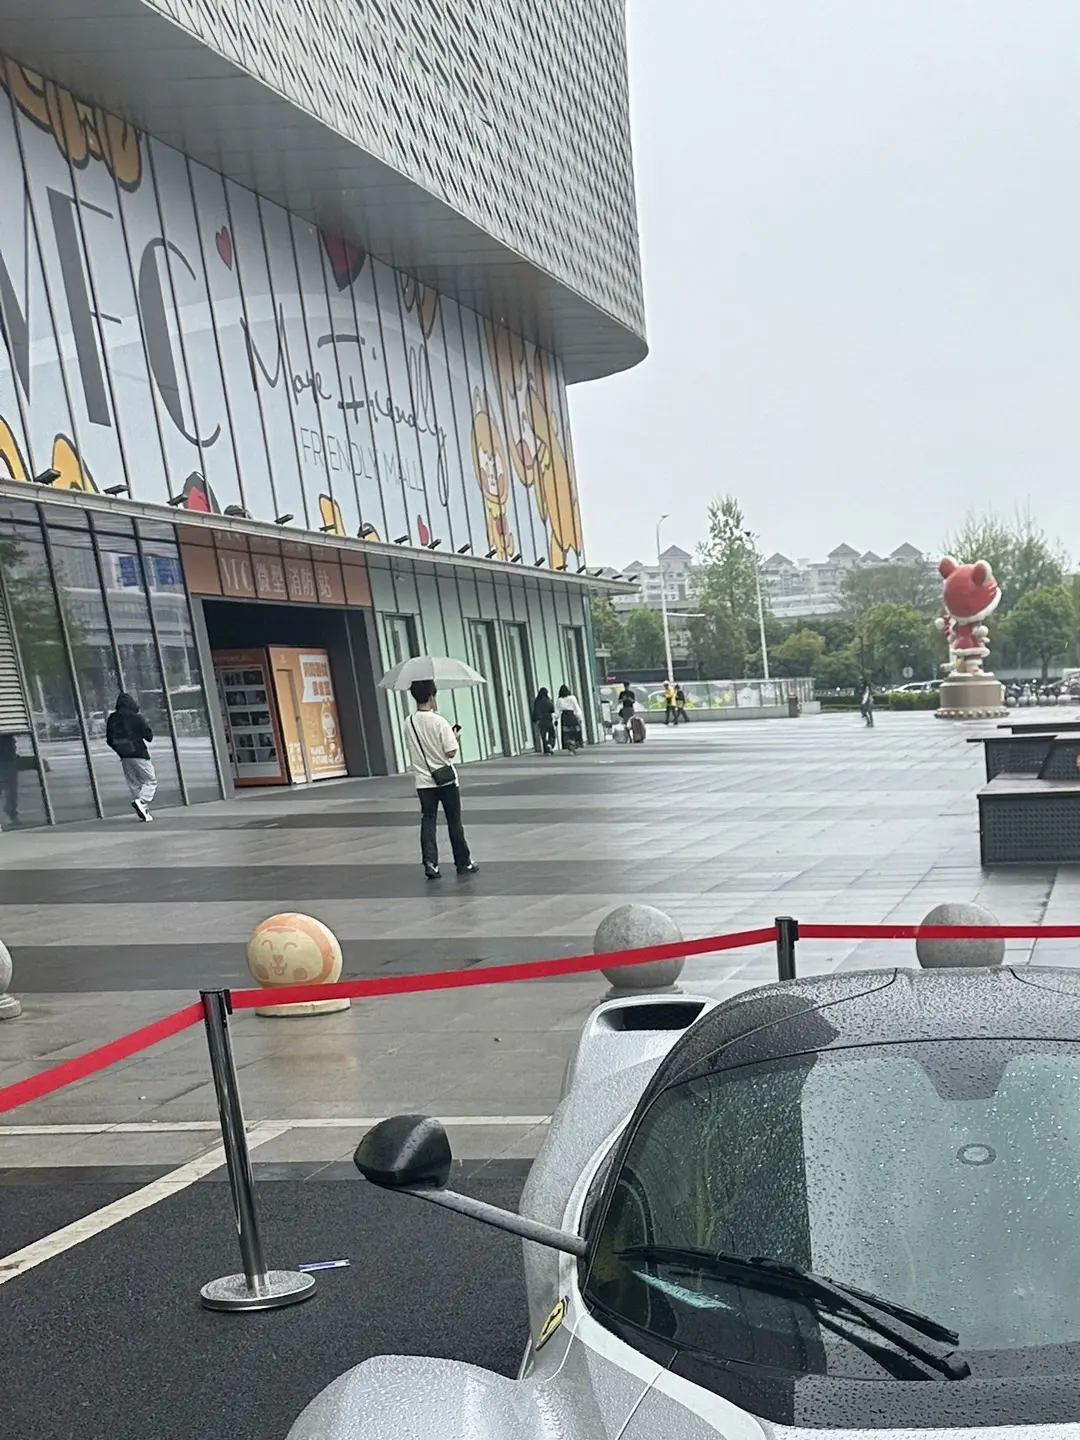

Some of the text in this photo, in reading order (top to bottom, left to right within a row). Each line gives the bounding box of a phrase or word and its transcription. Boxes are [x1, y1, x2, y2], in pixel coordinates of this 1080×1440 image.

[240, 302, 448, 507] More Friendly
[299, 426, 425, 492] FRENDLY MALL
